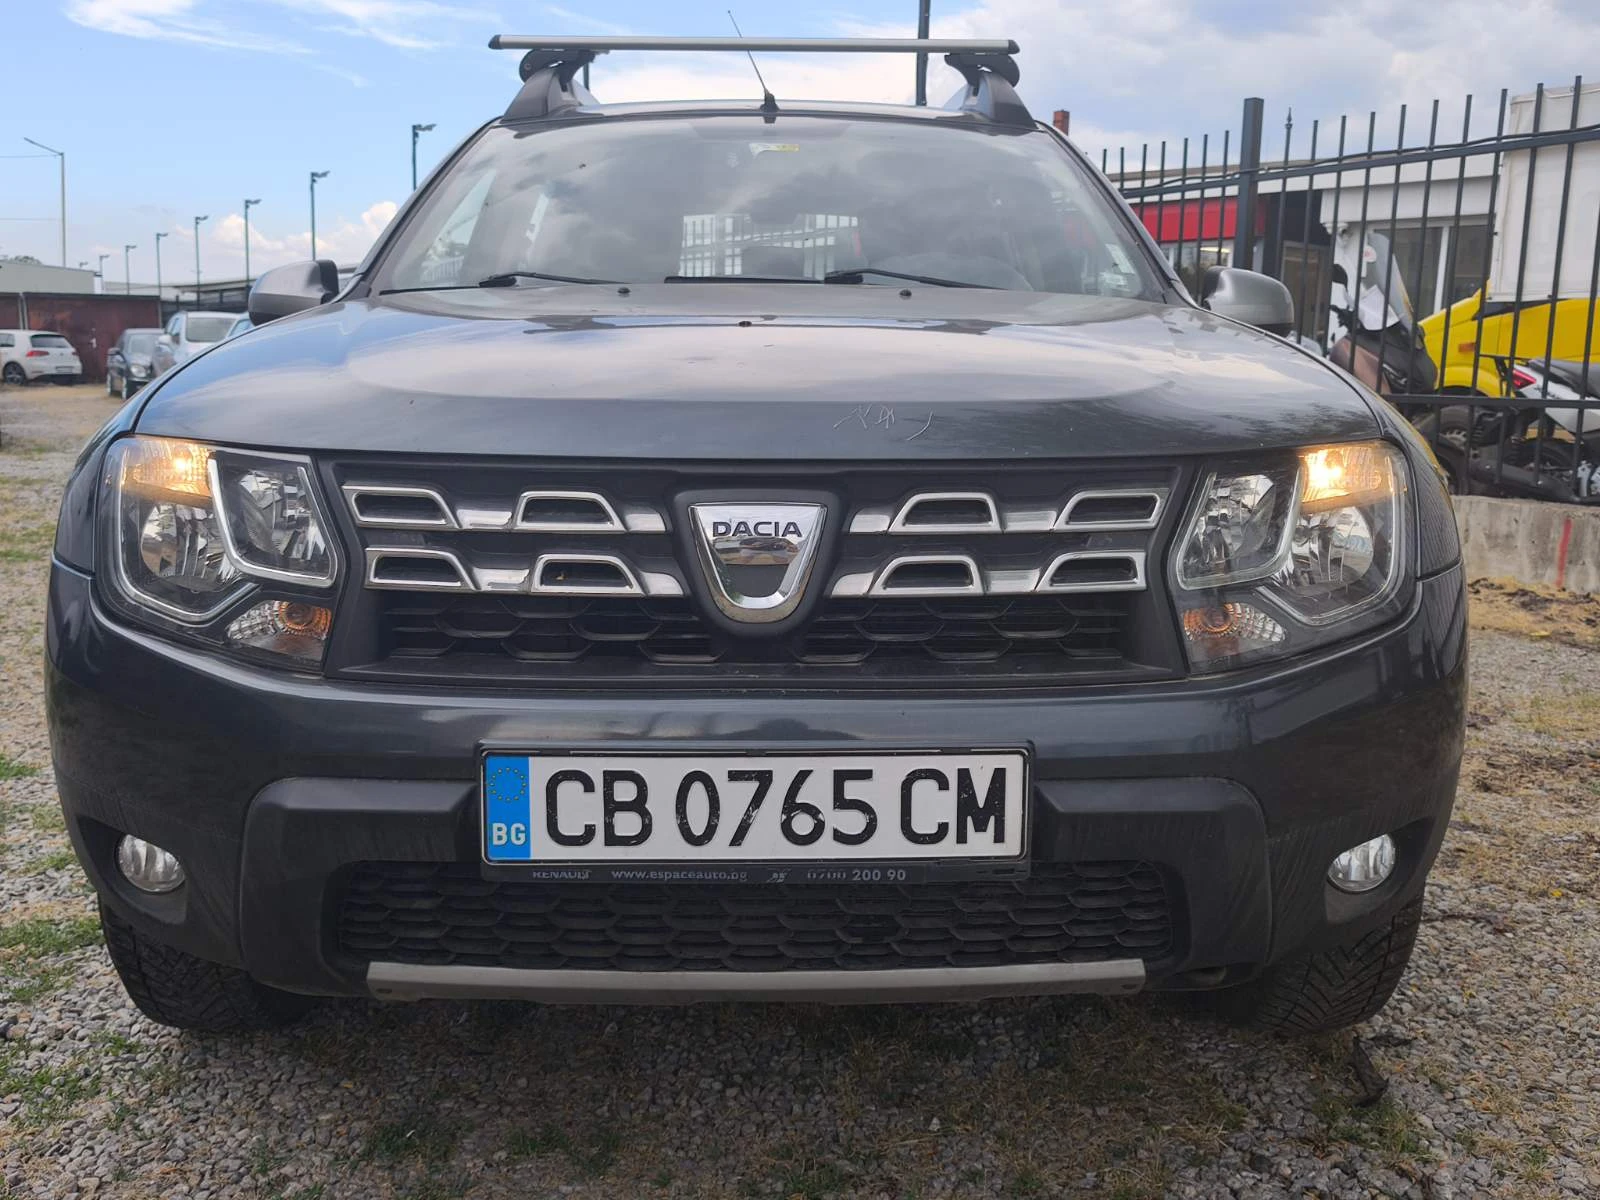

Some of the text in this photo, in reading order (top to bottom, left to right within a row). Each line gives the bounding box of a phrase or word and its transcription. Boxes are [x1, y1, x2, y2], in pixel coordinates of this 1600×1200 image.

[712, 521, 803, 538] DACIA
[545, 767, 1007, 847] CB 0765 CM
[492, 822, 526, 846] BG
[852, 869, 881, 881] 200
[886, 869, 906, 881] 90
